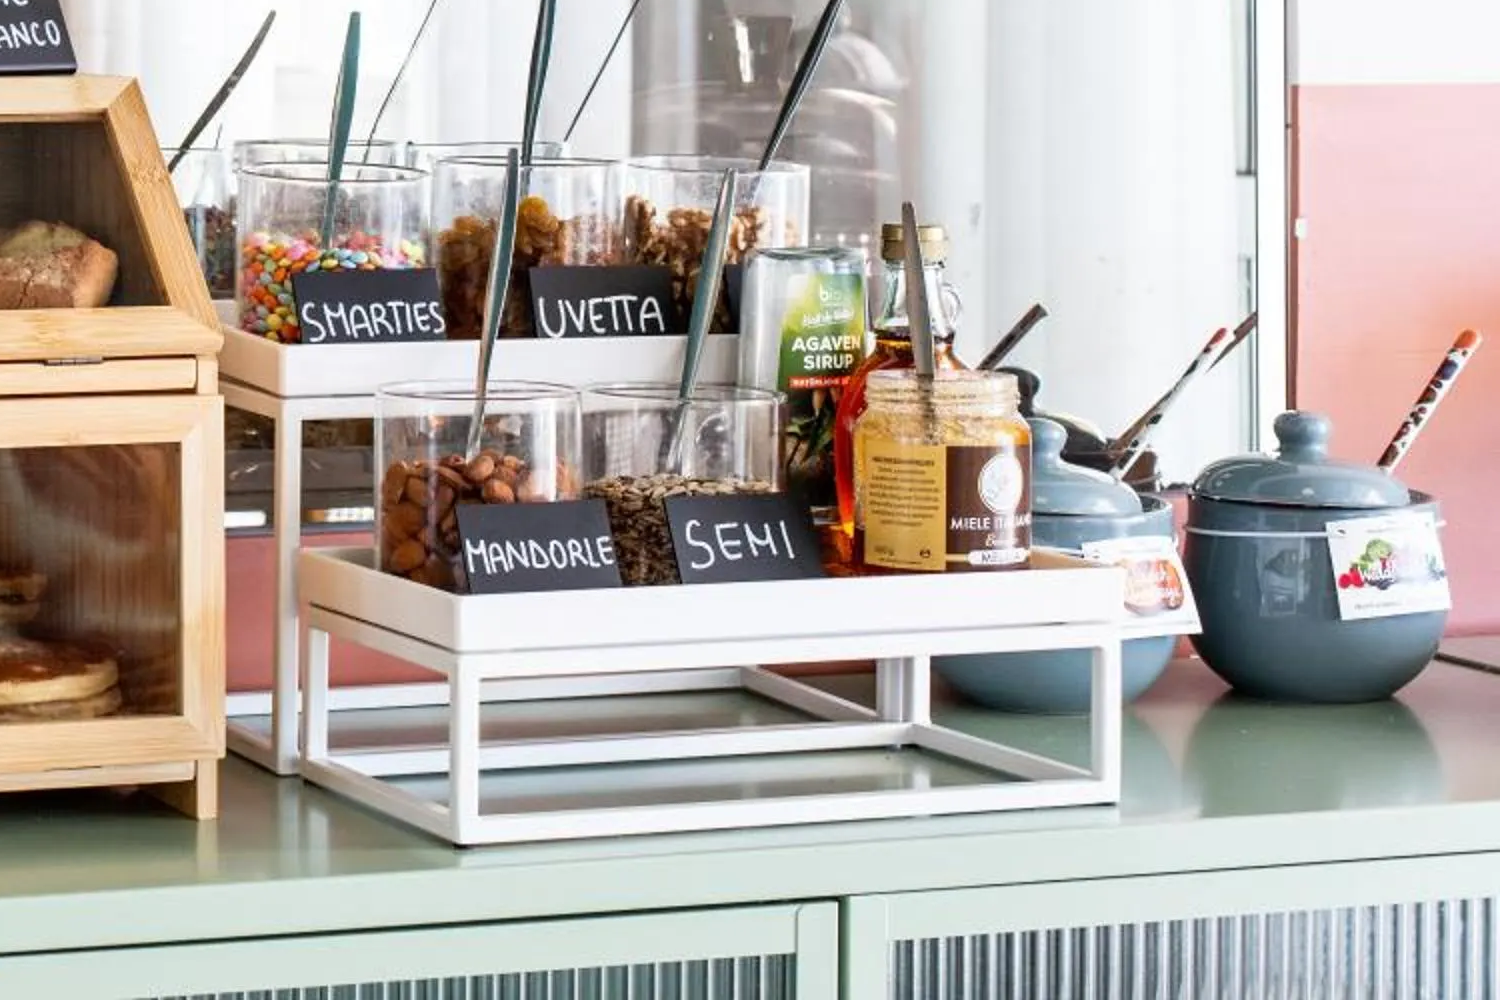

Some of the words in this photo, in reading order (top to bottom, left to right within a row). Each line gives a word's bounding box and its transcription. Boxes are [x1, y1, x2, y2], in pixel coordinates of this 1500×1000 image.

[301, 300, 447, 343] SMARTIES
[538, 295, 666, 339] UVETTA
[791, 335, 861, 352] AGAVEN
[803, 353, 855, 370] SIRUP
[950, 516, 991, 531] MIELE
[465, 535, 616, 576] MANDORLE
[685, 520, 795, 570] SEMI
